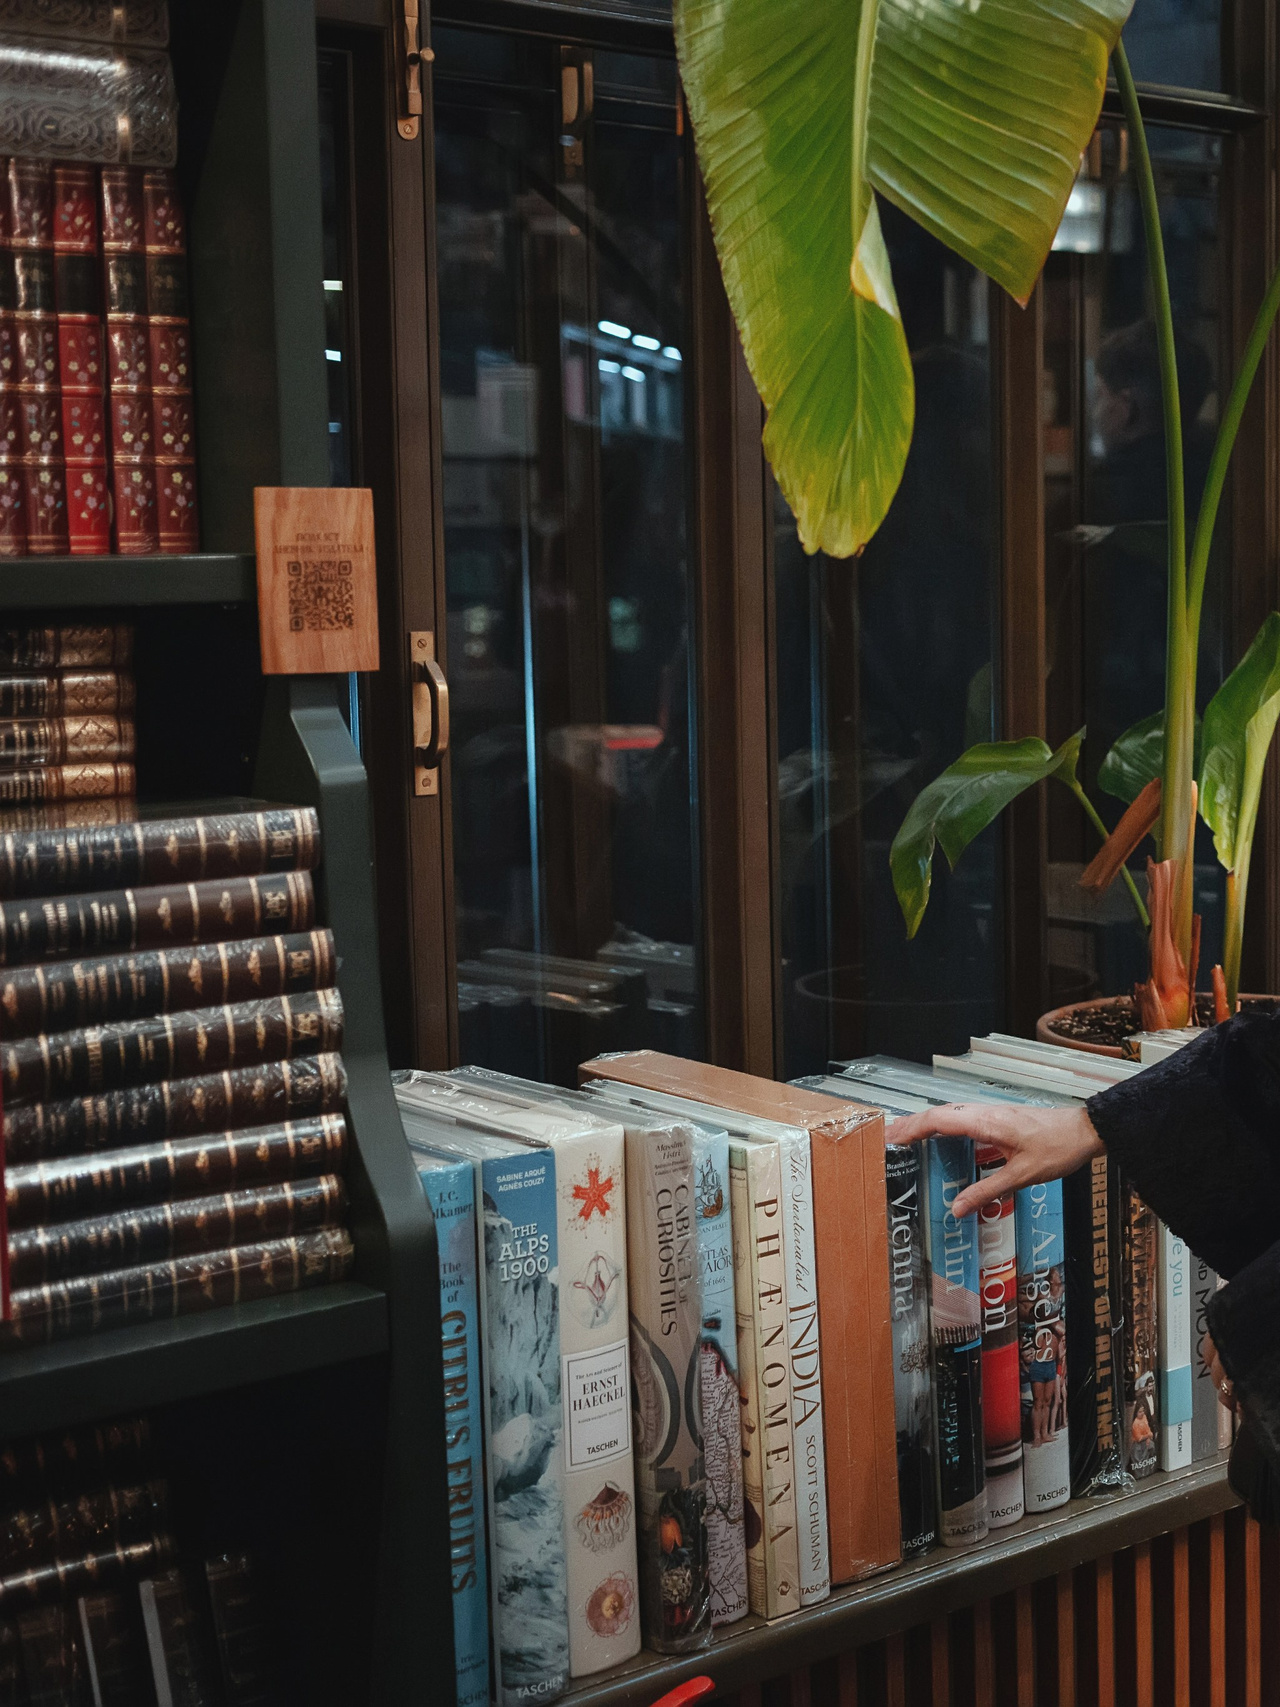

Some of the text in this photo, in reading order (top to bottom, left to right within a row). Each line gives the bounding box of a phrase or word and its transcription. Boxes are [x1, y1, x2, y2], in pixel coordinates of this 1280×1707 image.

[496, 1166, 546, 1183] SABINE ARQUÉ
[498, 1177, 546, 1192] AGNÈS COUZY
[432, 1203, 473, 1220] lkamer
[512, 1223, 538, 1239] THE
[499, 1234, 549, 1262] ALPS
[890, 1180, 918, 1315] Vienna
[442, 1262, 461, 1276] The
[500, 1256, 549, 1282] 1900
[656, 1188, 678, 1336] CURIOSITIES
[703, 1255, 732, 1274] AIOR
[1026, 1183, 1060, 1363] os Angeles
[1170, 1260, 1183, 1297] you
[447, 1291, 459, 1304] of
[1094, 1297, 1111, 1329] OF
[789, 1300, 820, 1430] INDIA
[1095, 1334, 1112, 1384] ALL
[583, 1374, 618, 1395] ERNST
[573, 1387, 625, 1411] HAECKEL
[1096, 1390, 1114, 1453] TIME
[441, 1310, 477, 1594] CITRUS FRUITS
[587, 1439, 618, 1454] TASCHEN
[806, 1435, 818, 1486] SCOTT
[1131, 1456, 1157, 1470] TASCHEN
[1036, 1486, 1068, 1503] TASCHEN
[990, 1502, 1023, 1519] TASCHEN
[808, 1491, 822, 1572] SCHUMAN
[951, 1520, 986, 1536] TASCHEN
[902, 1531, 935, 1549] TASCHEN
[801, 1579, 830, 1595] TASCHEN
[711, 1599, 746, 1618] TASCHEN
[516, 1674, 563, 1698] TASCHEN
